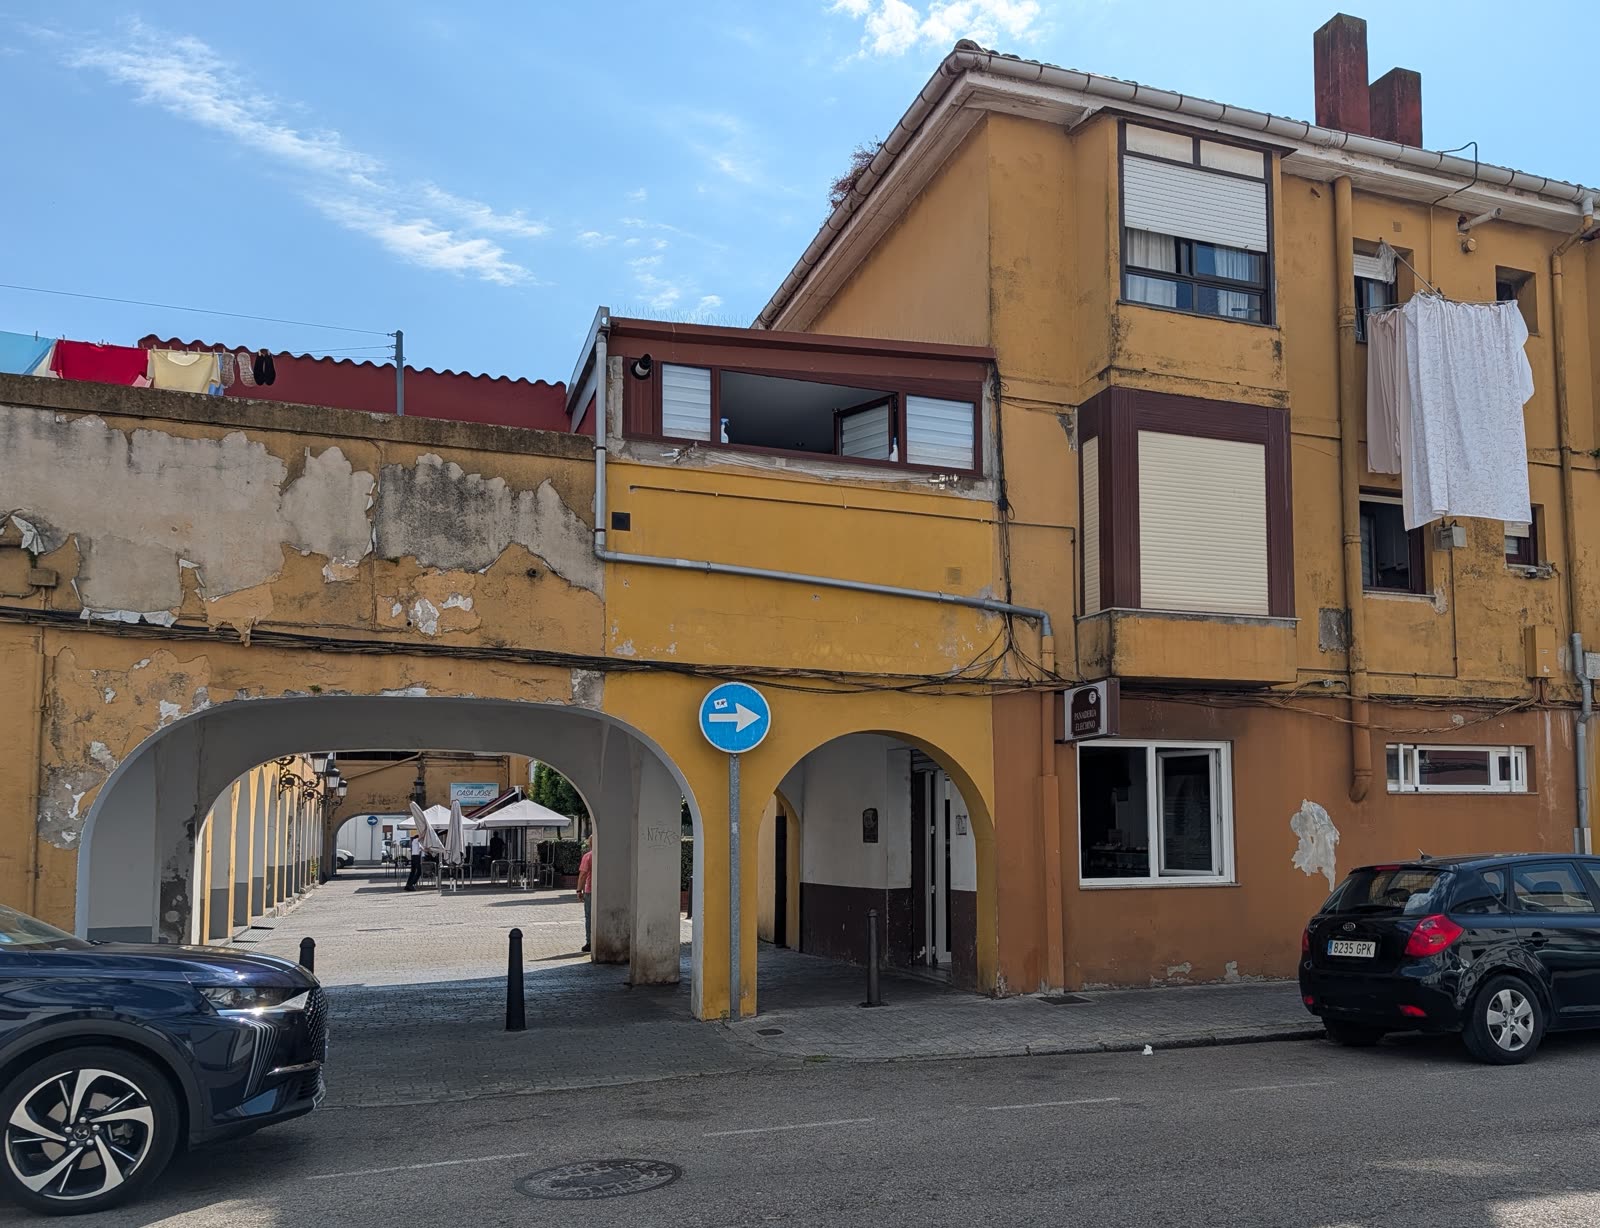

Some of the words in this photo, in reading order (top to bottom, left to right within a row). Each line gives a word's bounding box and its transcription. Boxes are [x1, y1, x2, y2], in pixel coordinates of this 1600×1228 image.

[456, 789, 474, 797] CASA
[1333, 942, 1354, 954] 8235
[1356, 943, 1373, 955] GPK
